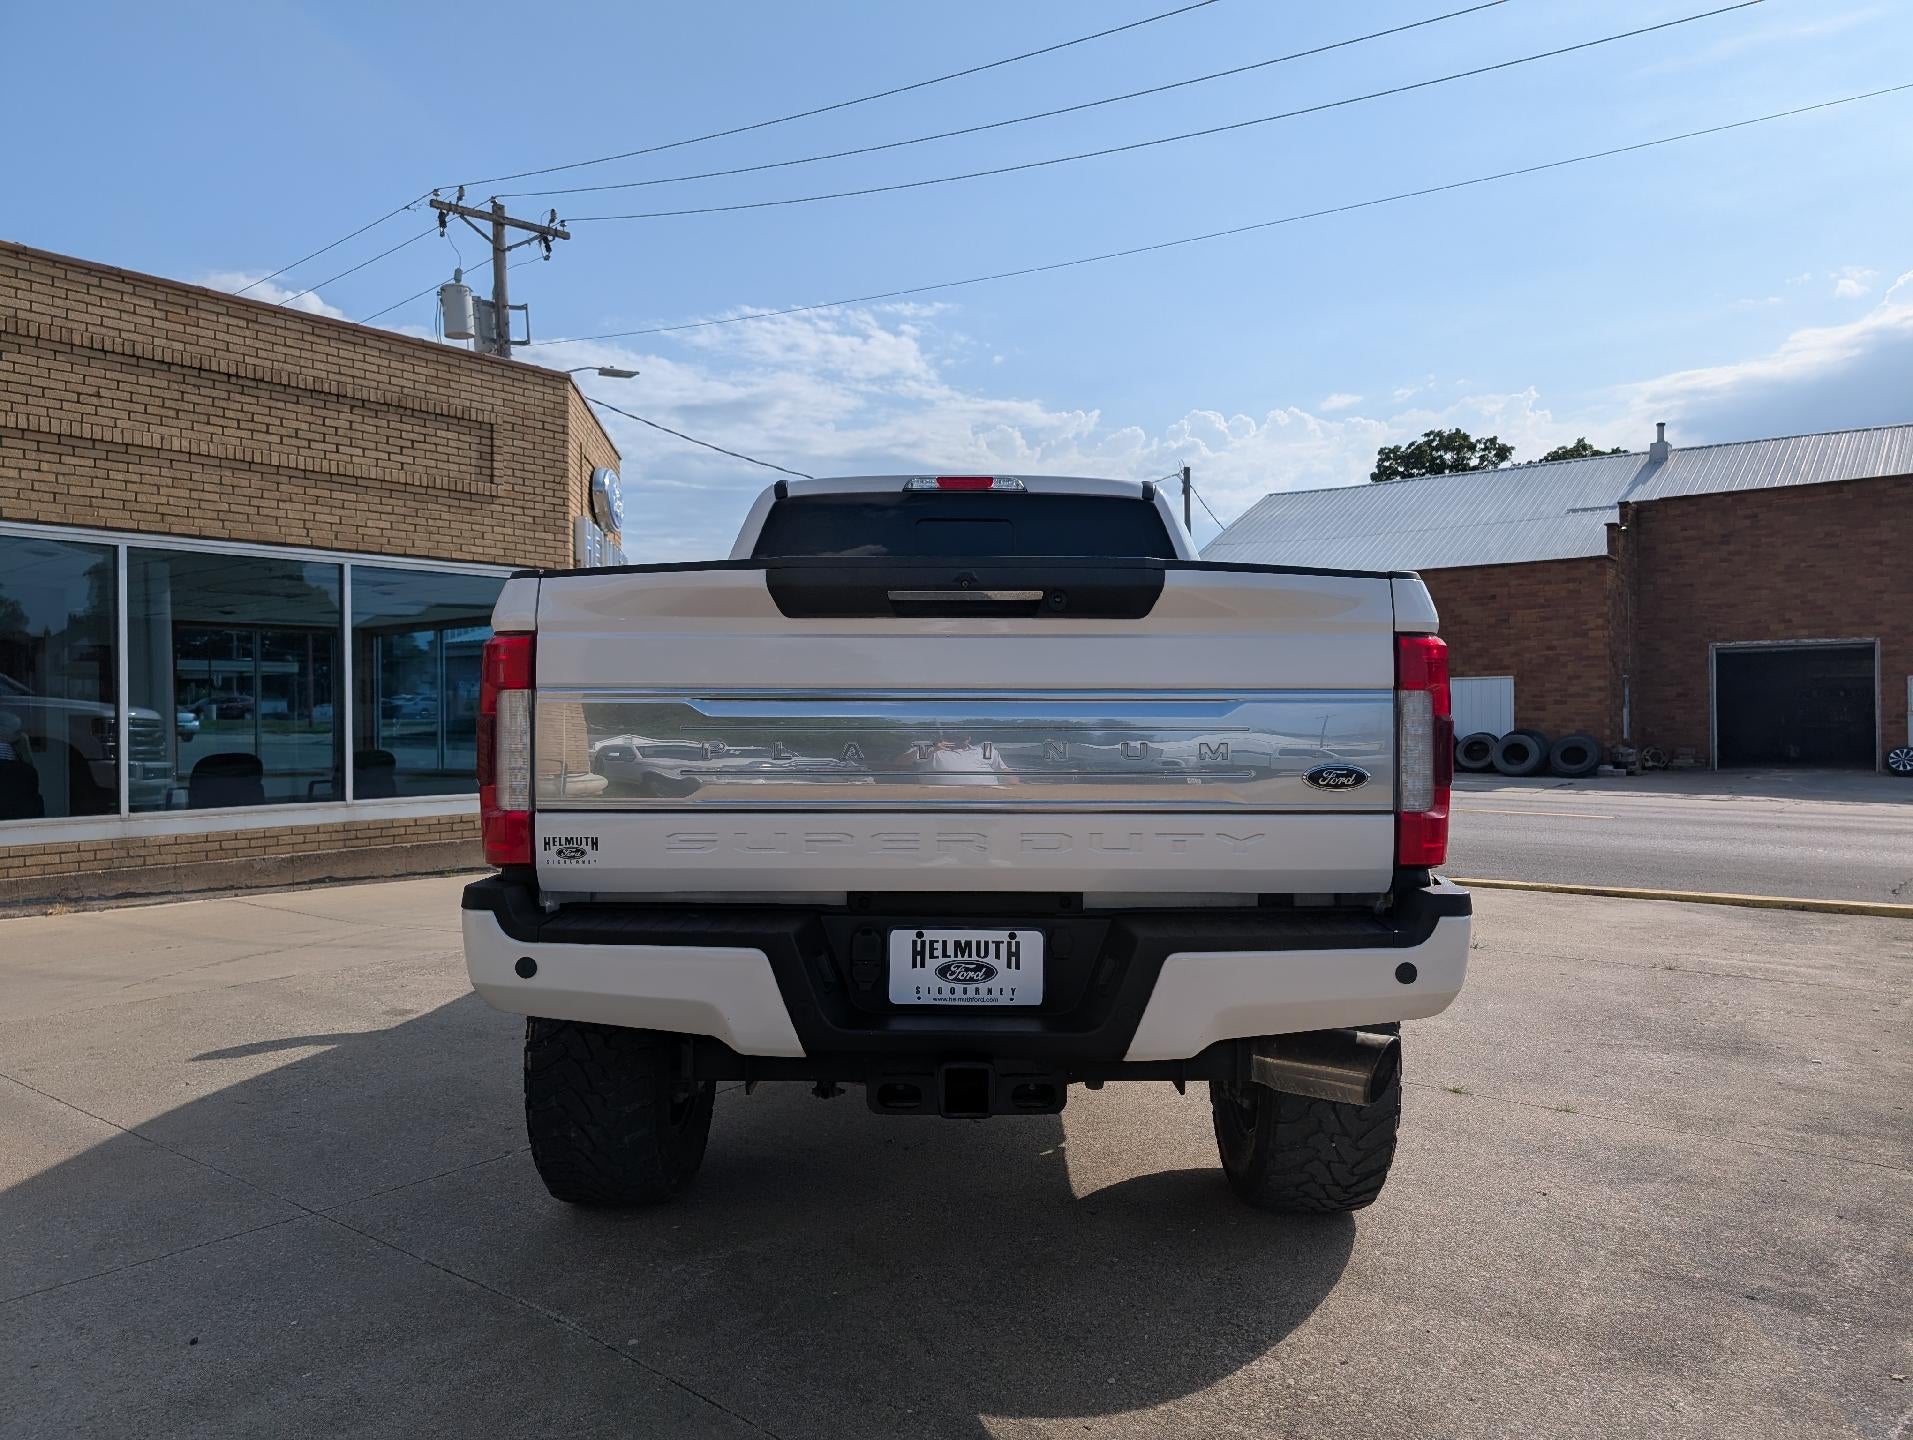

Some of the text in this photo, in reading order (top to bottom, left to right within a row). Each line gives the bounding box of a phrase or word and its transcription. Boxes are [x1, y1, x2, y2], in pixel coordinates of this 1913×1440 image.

[701, 741, 1231, 761] PLATINUM
[1318, 769, 1357, 785] Ford
[543, 836, 599, 851] HELMUTH
[665, 832, 1266, 854] SUPER DUTY
[911, 939, 1021, 970] HELMUTH
[946, 963, 987, 980] Ford
